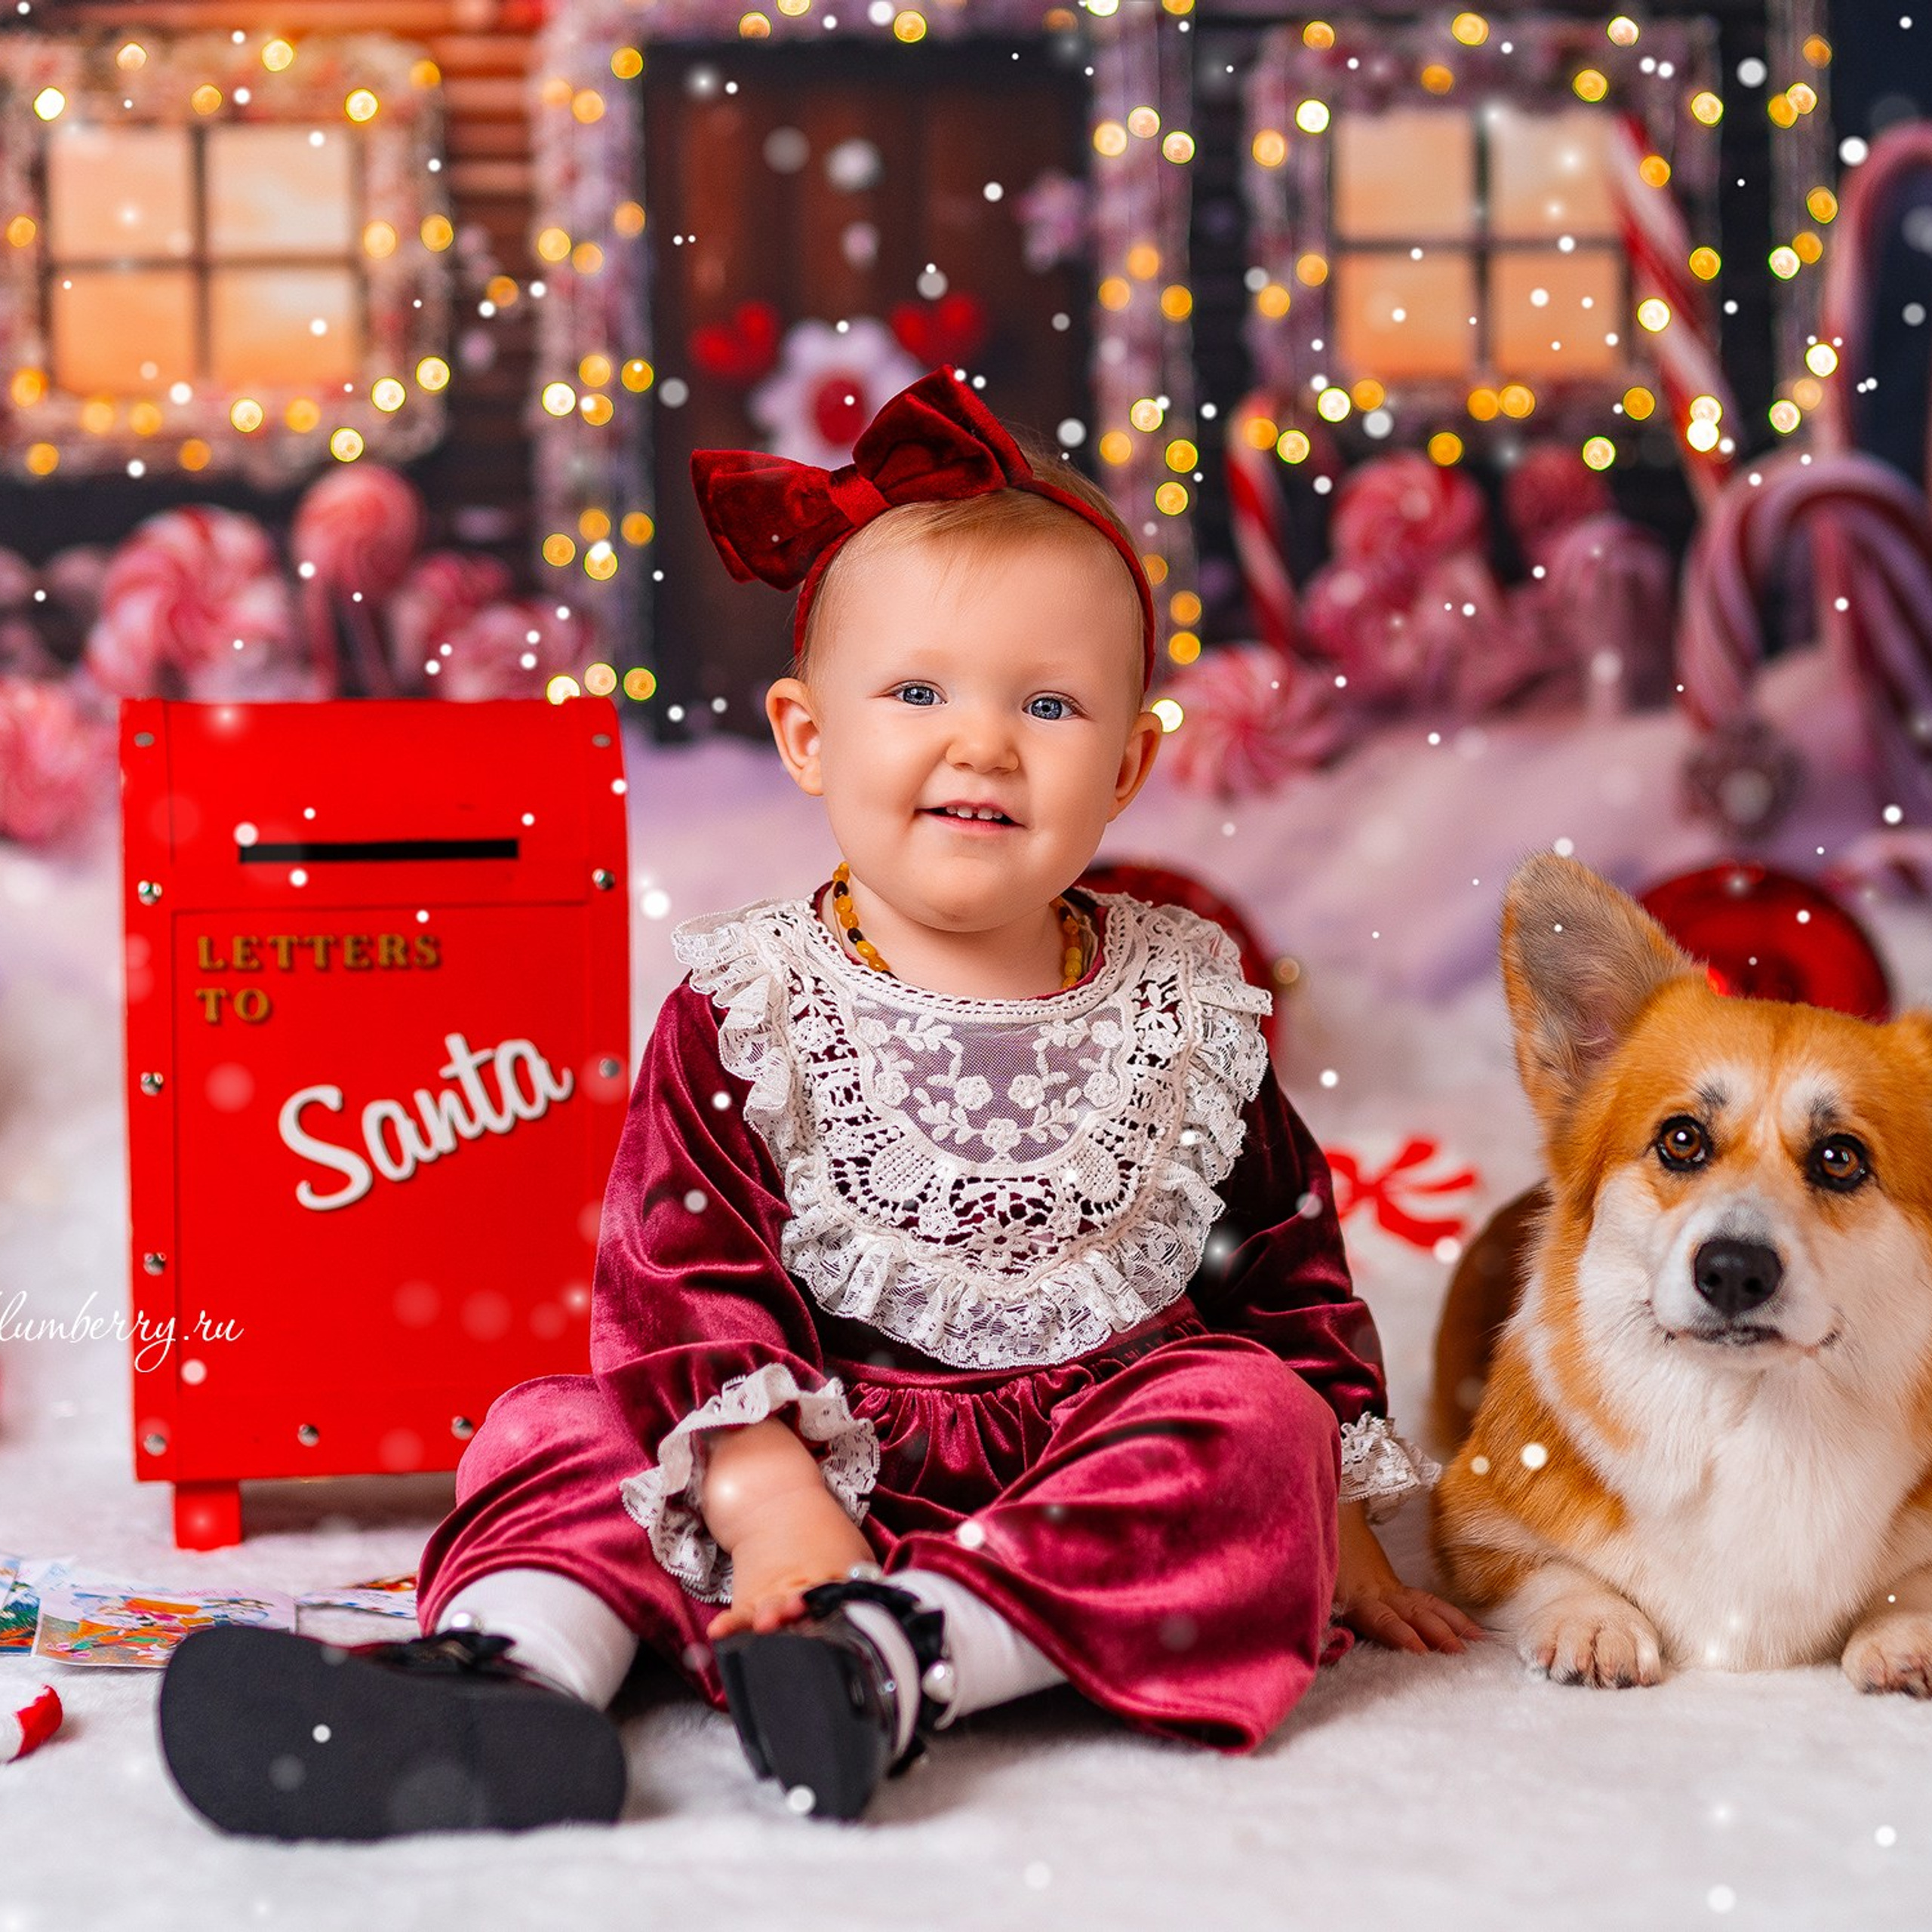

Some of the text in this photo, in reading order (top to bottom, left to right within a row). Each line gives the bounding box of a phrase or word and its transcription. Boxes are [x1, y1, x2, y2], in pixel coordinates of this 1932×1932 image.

[197, 934, 441, 971] LETTERS
[195, 988, 272, 1024] TO
[278, 1032, 574, 1211] Santa
